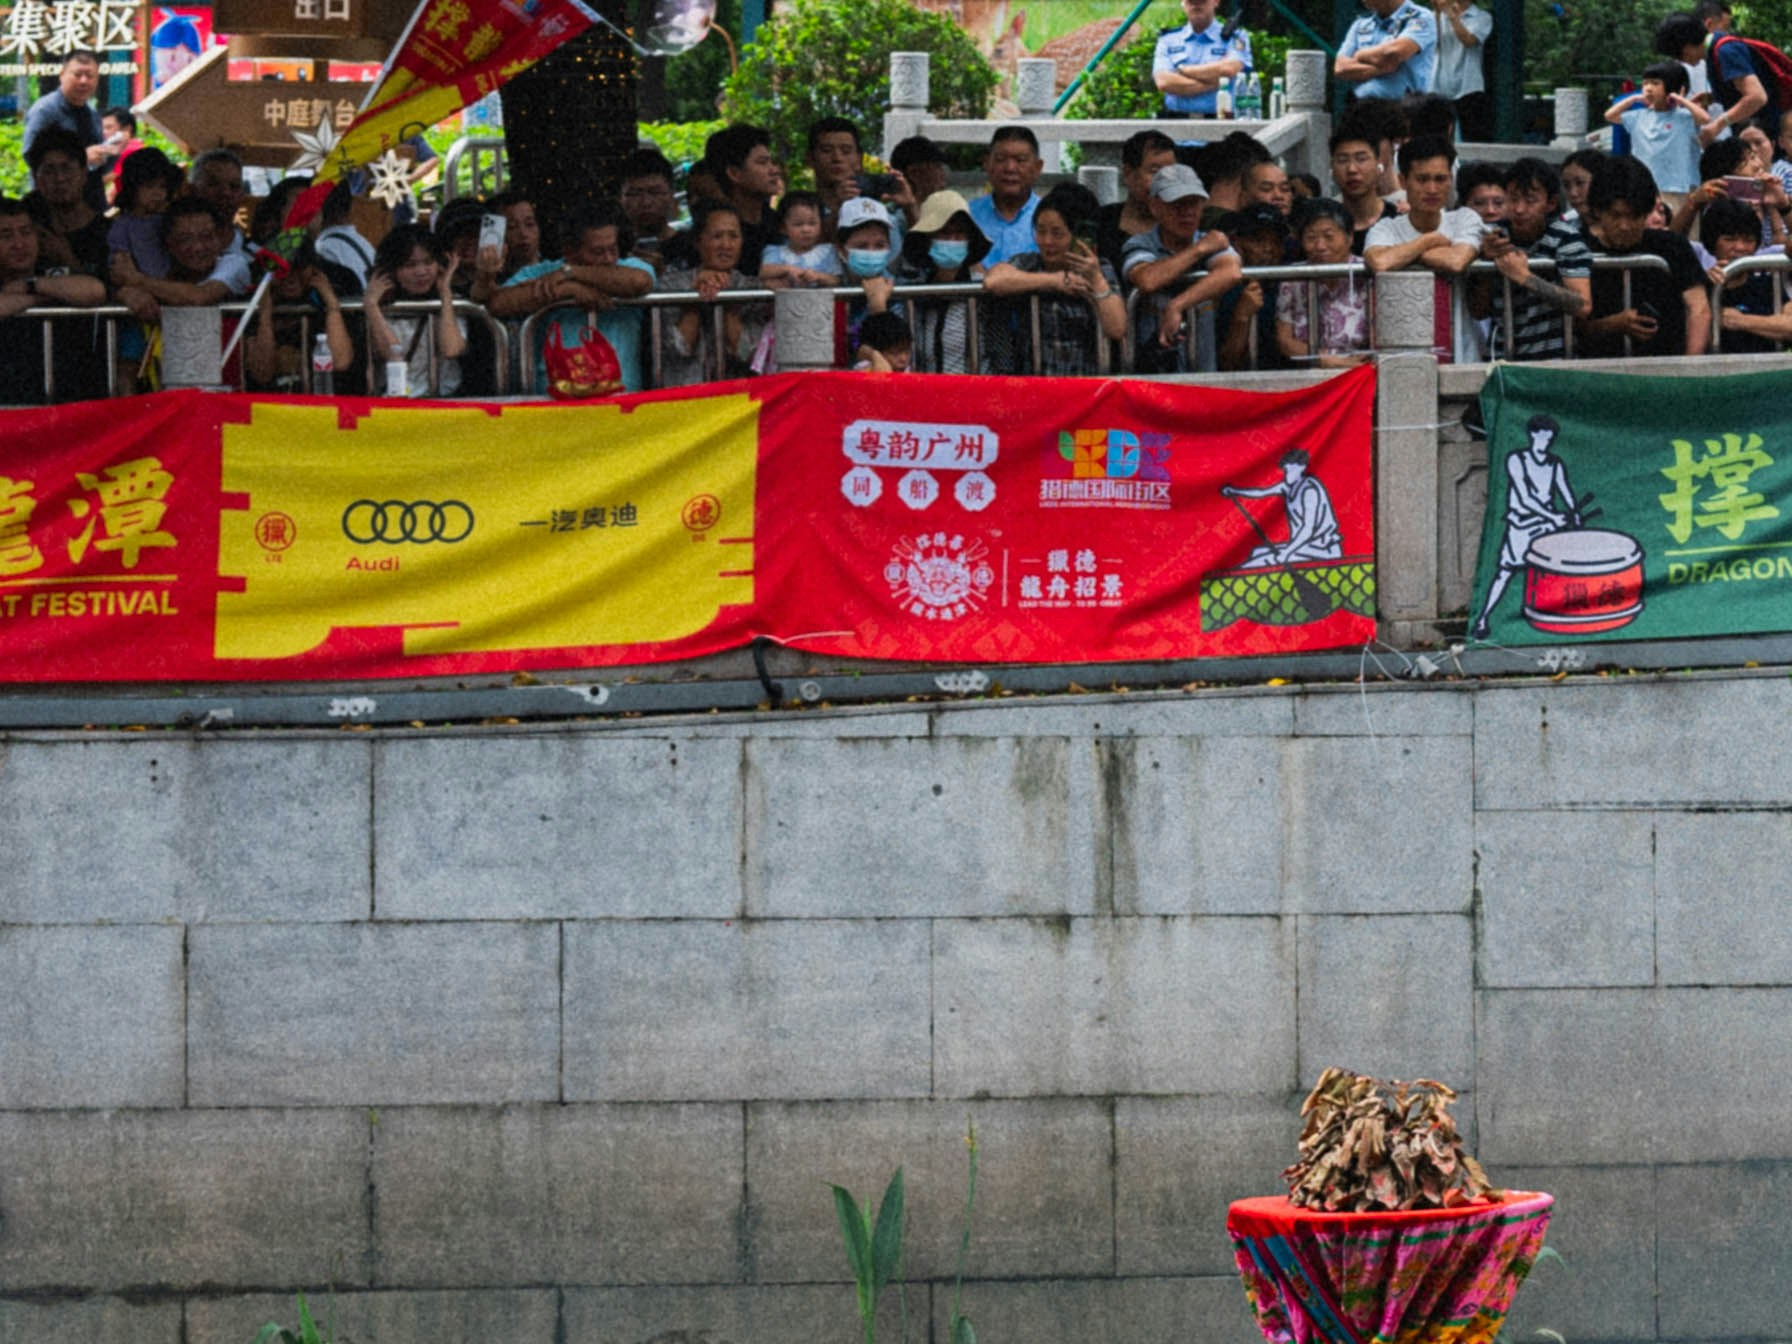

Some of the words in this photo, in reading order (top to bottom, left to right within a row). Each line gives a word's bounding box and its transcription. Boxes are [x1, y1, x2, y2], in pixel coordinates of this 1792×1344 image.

[855, 427, 985, 463] 粤韵广州
[519, 501, 639, 535] 一汽奥迪
[345, 556, 401, 572] Audi
[30, 590, 179, 617] FESTIVAL
